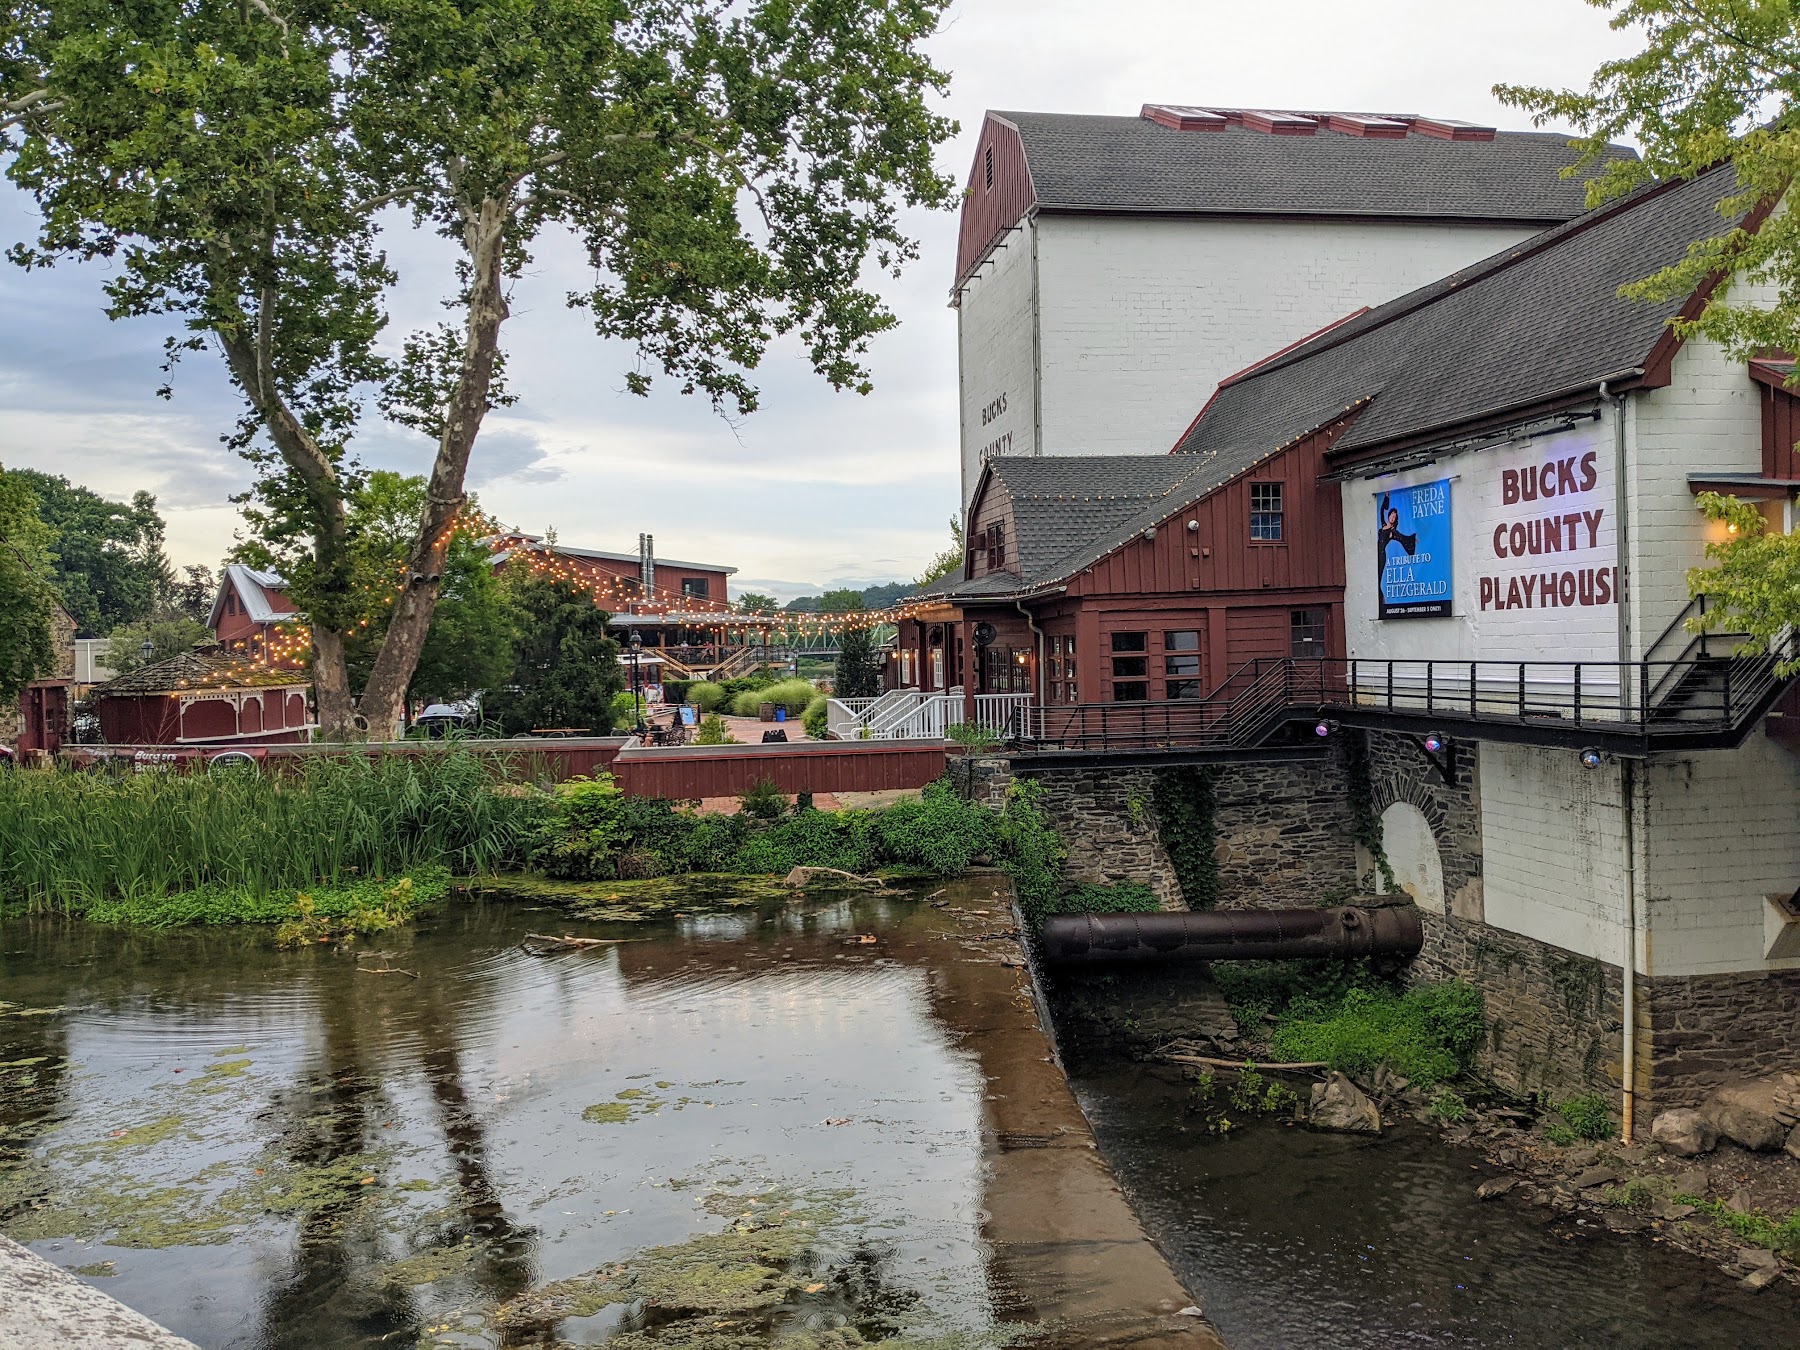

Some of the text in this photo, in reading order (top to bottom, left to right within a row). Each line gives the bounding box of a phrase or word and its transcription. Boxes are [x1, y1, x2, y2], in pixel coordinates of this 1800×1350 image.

[982, 391, 1008, 427] BUCKS
[979, 430, 1013, 467] COUNTY
[1502, 451, 1597, 506] BUCKS
[1412, 485, 1445, 505] FREDA
[1412, 500, 1445, 519] PAYNE
[1493, 508, 1604, 559] COUNTY
[1386, 552, 1431, 567] A TRIBUTE TO
[1386, 566, 1415, 584] ELLA
[1386, 580, 1447, 598] FITZGERALD
[134, 750, 178, 764] Burgers
